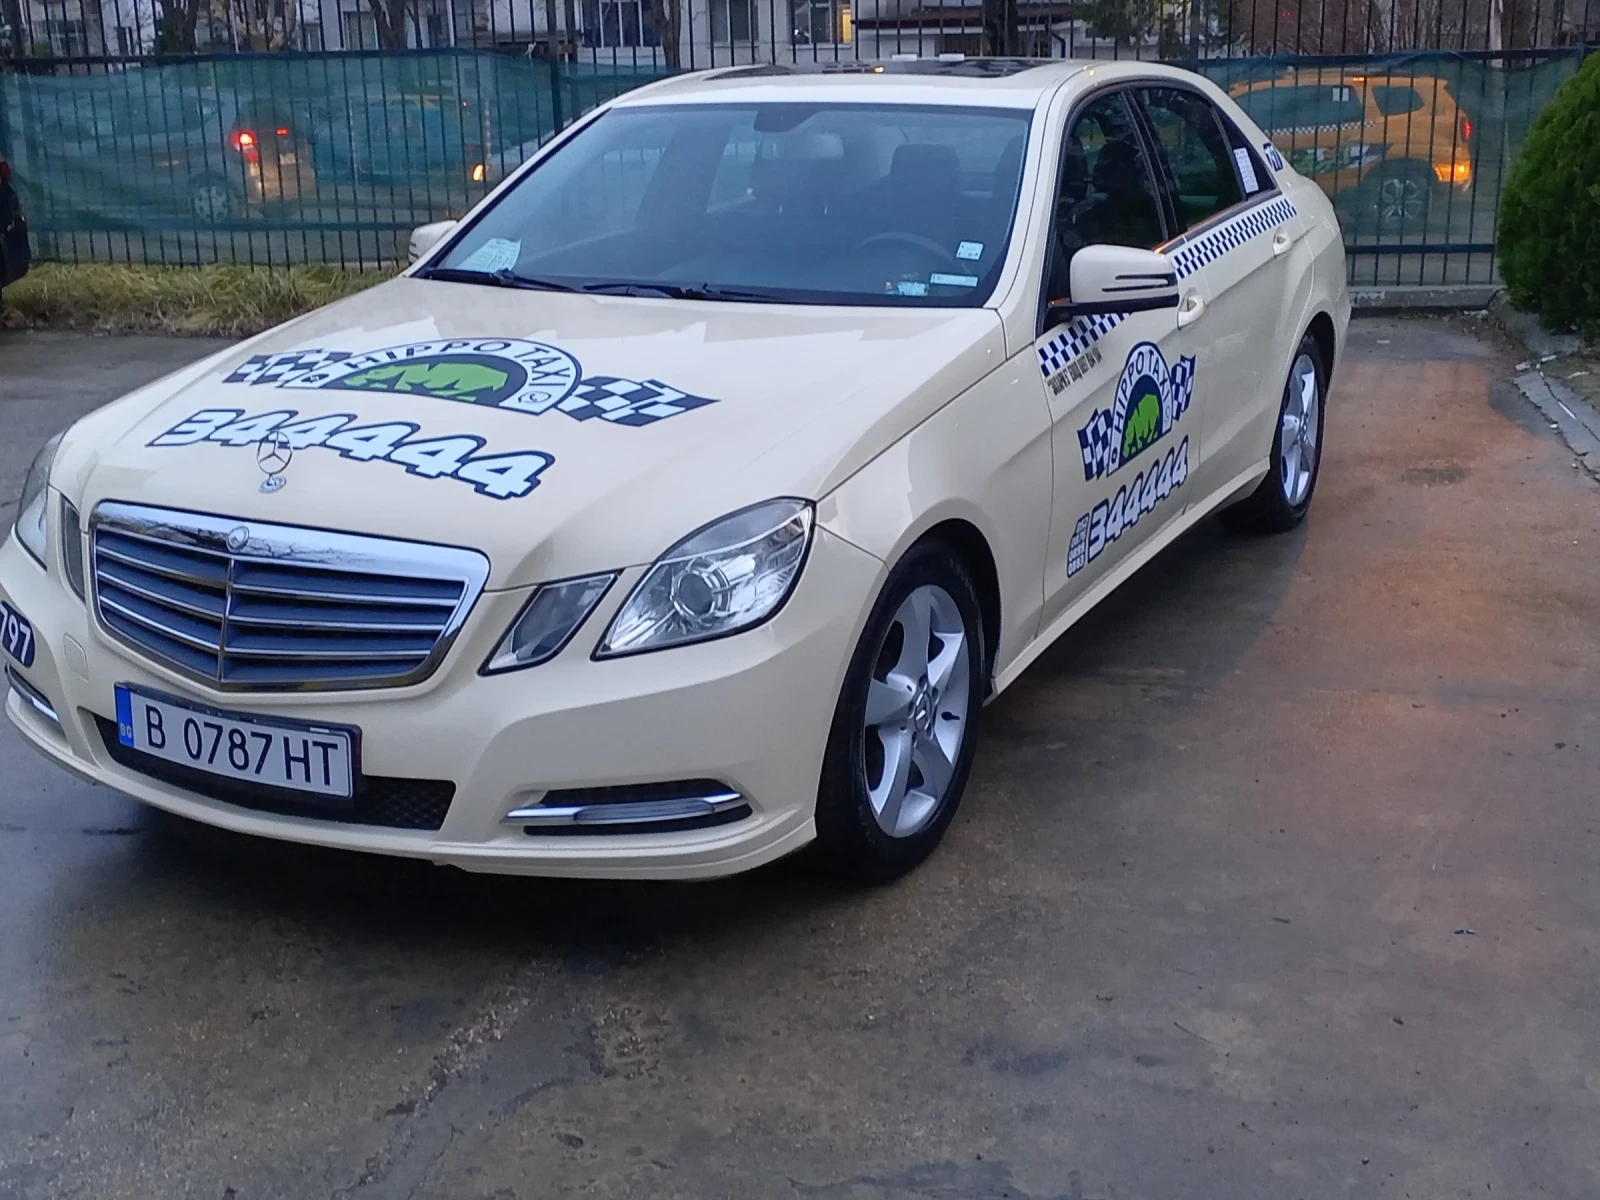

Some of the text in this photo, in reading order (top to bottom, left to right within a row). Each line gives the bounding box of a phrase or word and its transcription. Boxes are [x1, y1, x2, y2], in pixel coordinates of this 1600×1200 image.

[343, 340, 571, 387] HIPPO TAXI
[1113, 350, 1145, 434] HIPPO
[1149, 349, 1171, 398] TAXI
[145, 409, 555, 500] 344444
[1088, 434, 1189, 564] 344444
[145, 704, 339, 787] B 0787 HT
